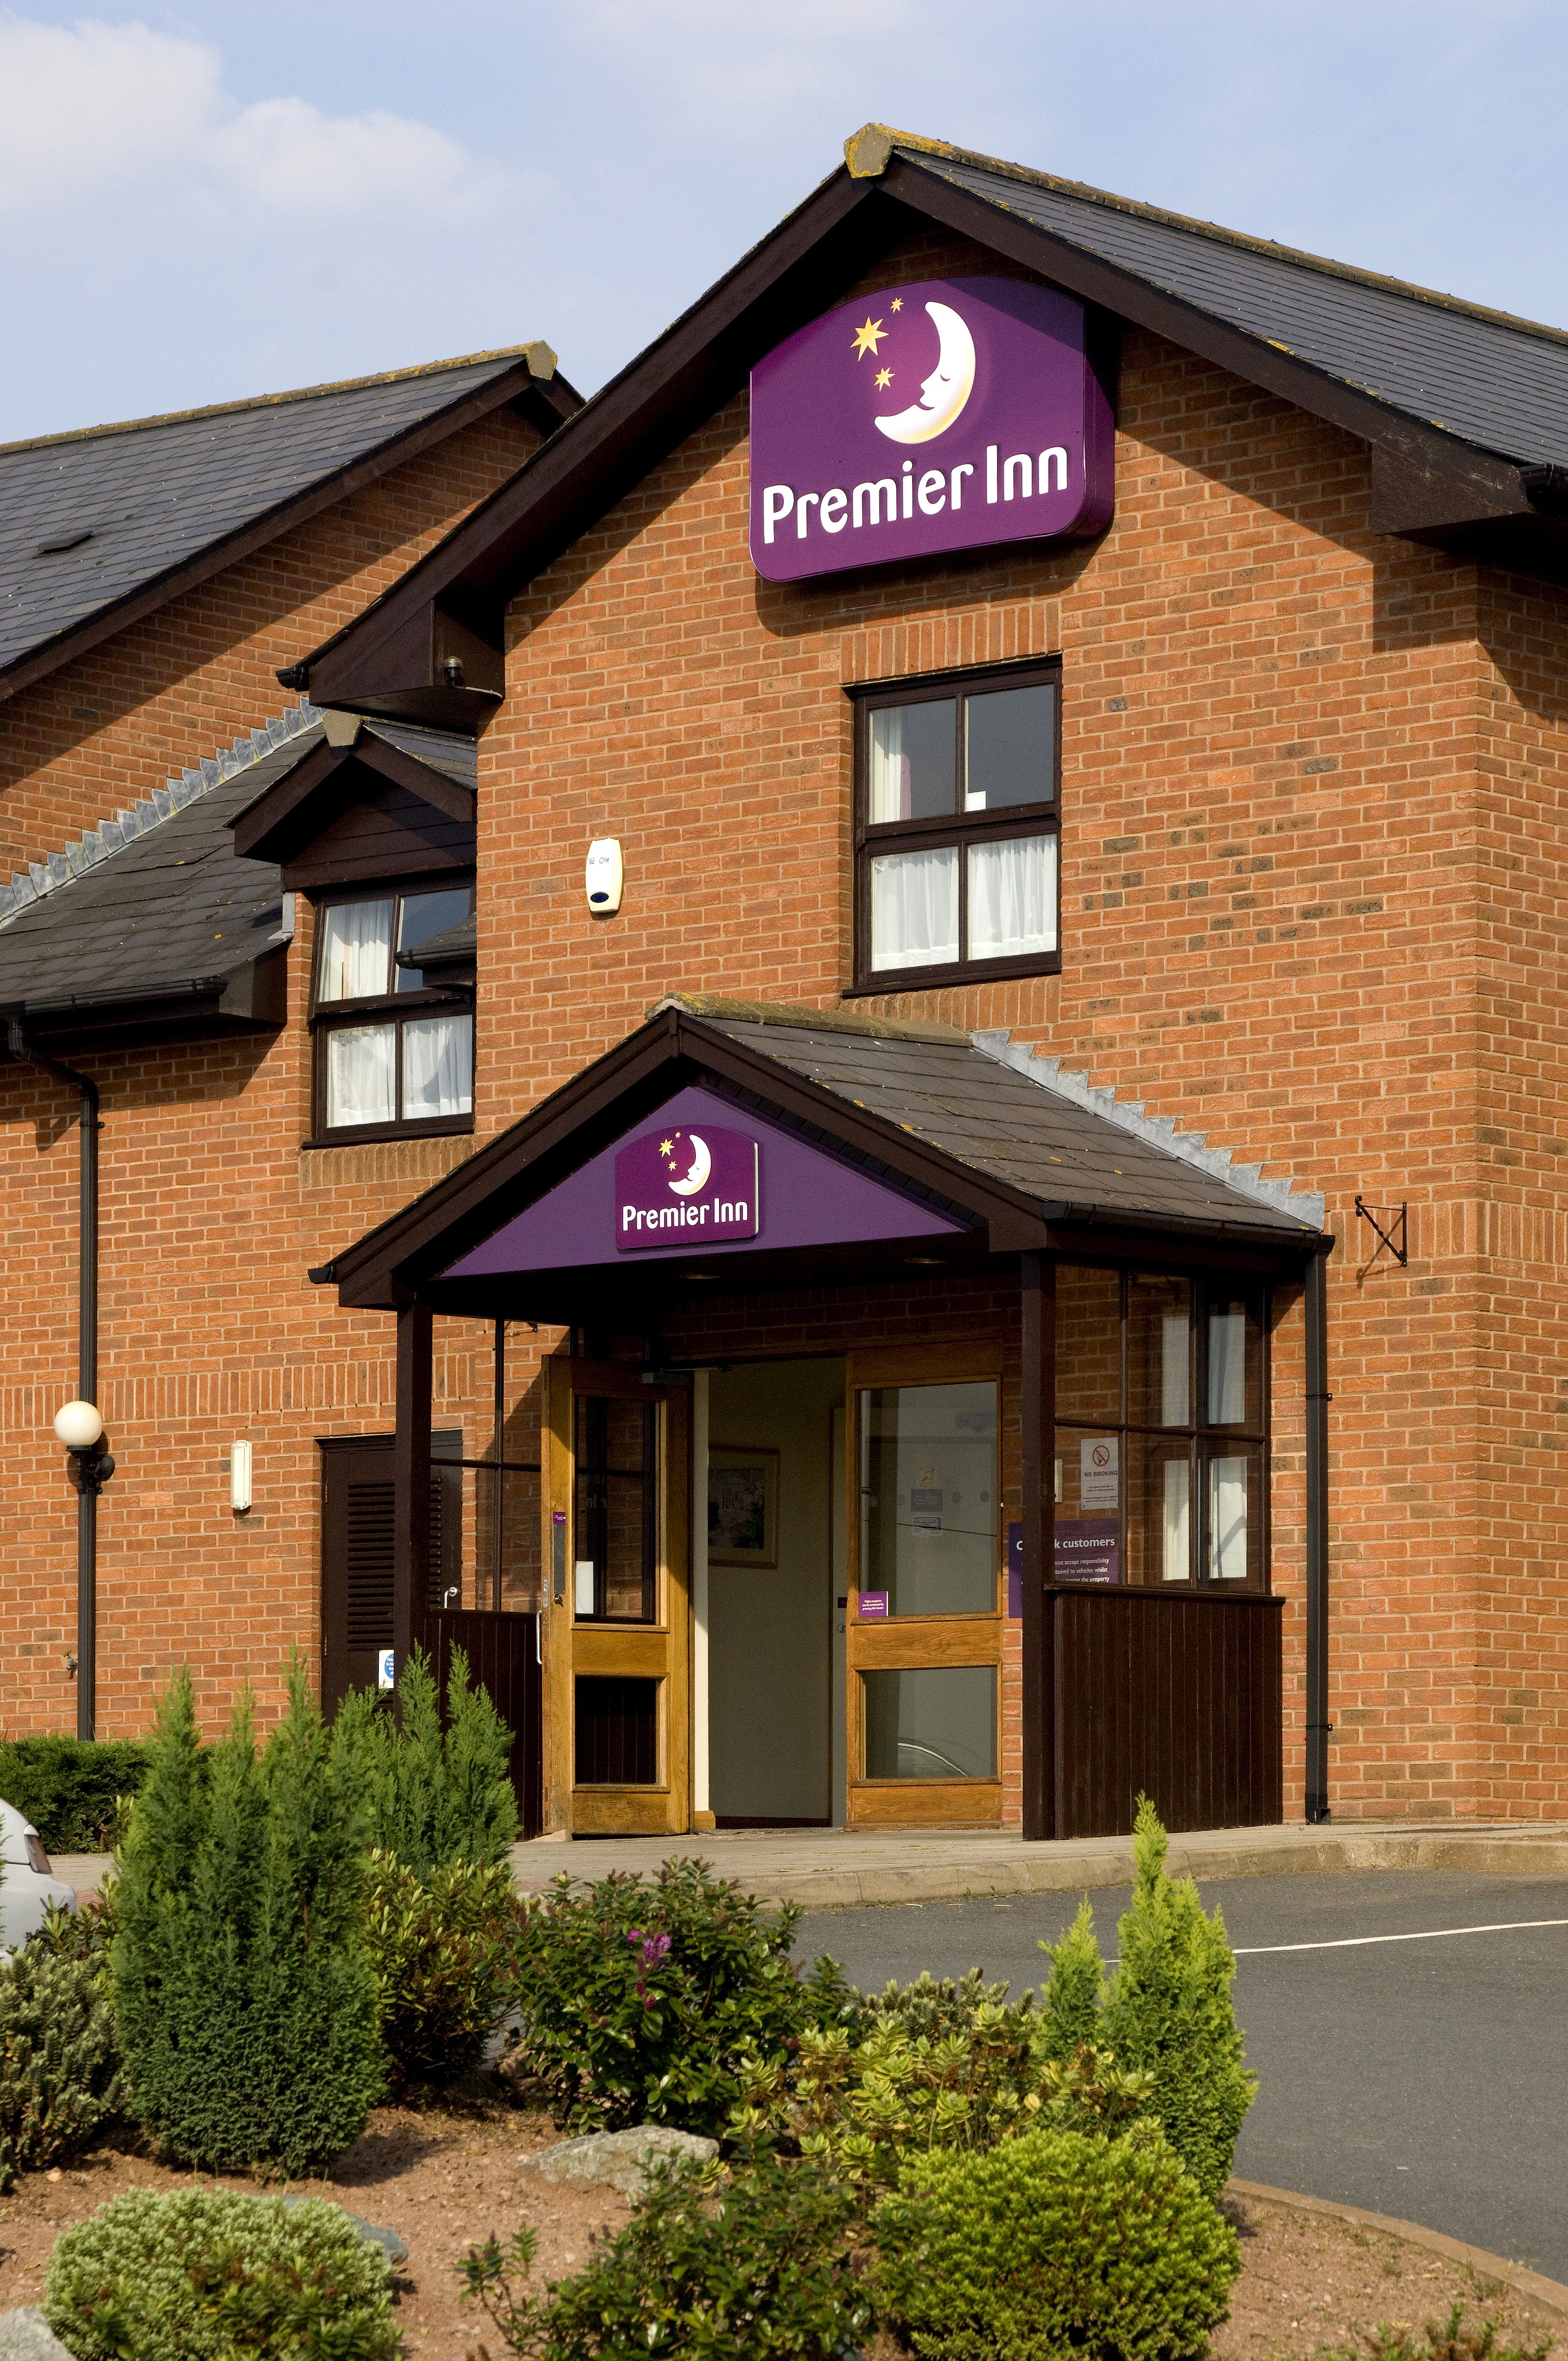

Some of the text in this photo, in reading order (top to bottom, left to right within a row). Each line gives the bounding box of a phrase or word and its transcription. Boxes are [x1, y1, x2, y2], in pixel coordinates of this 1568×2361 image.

[763, 444, 1068, 544] Premier Inn
[623, 1198, 748, 1231] Premier Inn
[1063, 1538, 1115, 1548] customers
